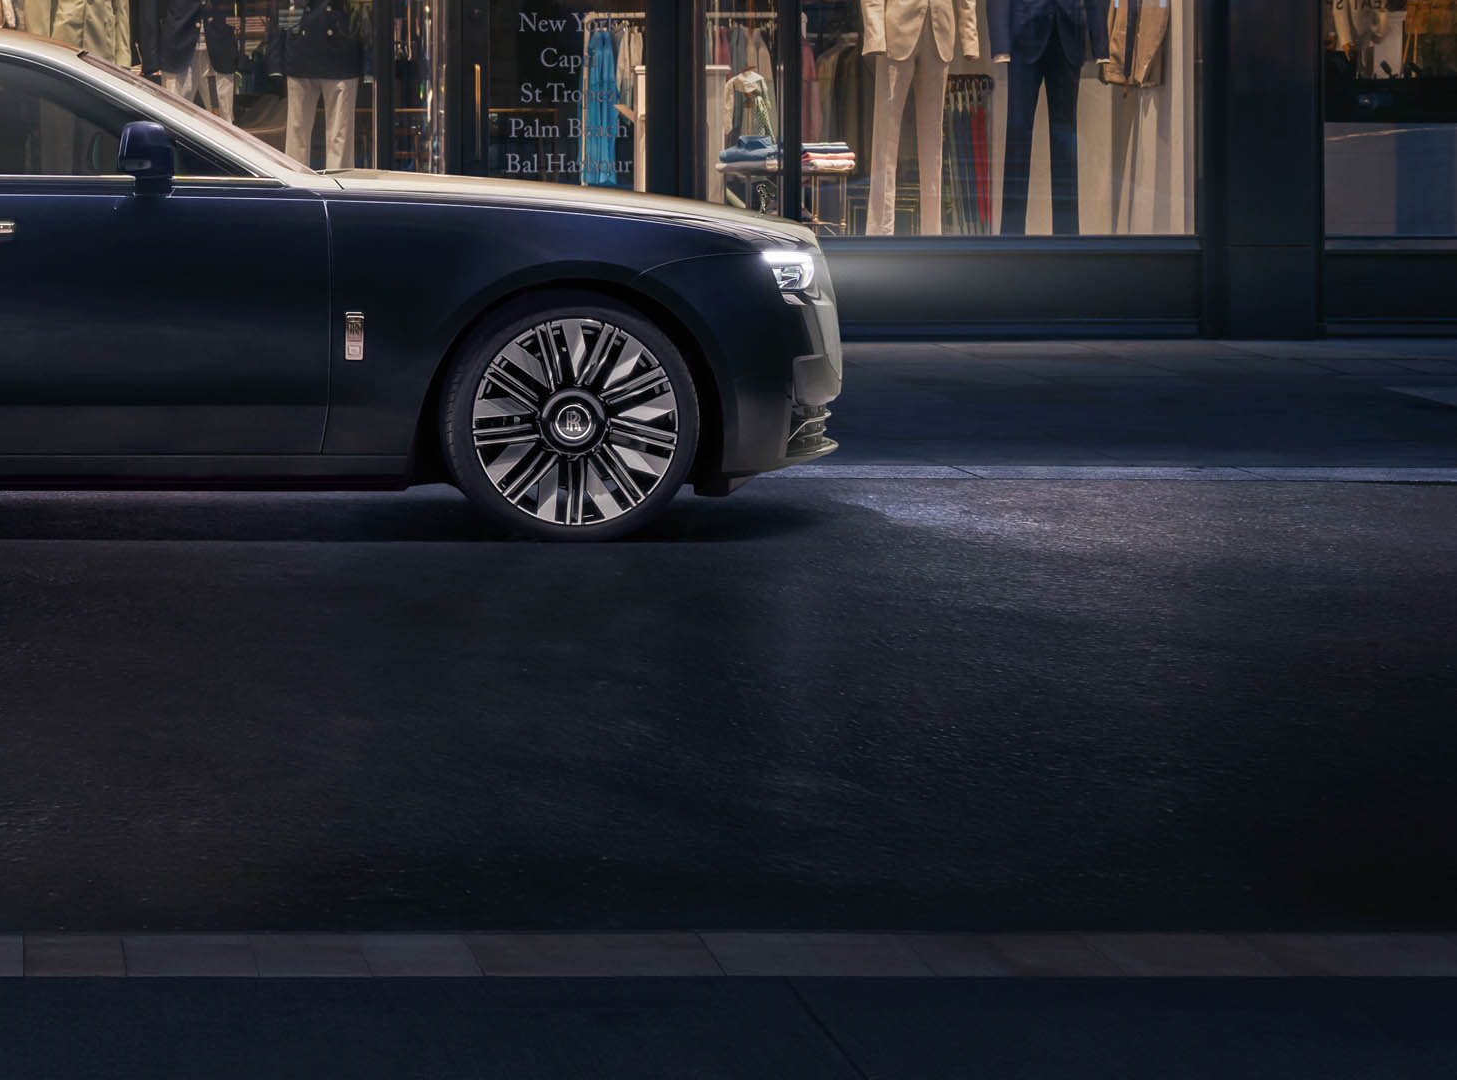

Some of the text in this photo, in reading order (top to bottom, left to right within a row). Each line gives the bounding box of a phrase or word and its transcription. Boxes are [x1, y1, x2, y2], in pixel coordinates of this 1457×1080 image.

[518, 12, 617, 33] New York
[539, 47, 598, 75] Capri
[520, 82, 617, 110] St Tropez
[509, 118, 629, 139] Palm Beach
[506, 153, 633, 174] Bal Harbour
